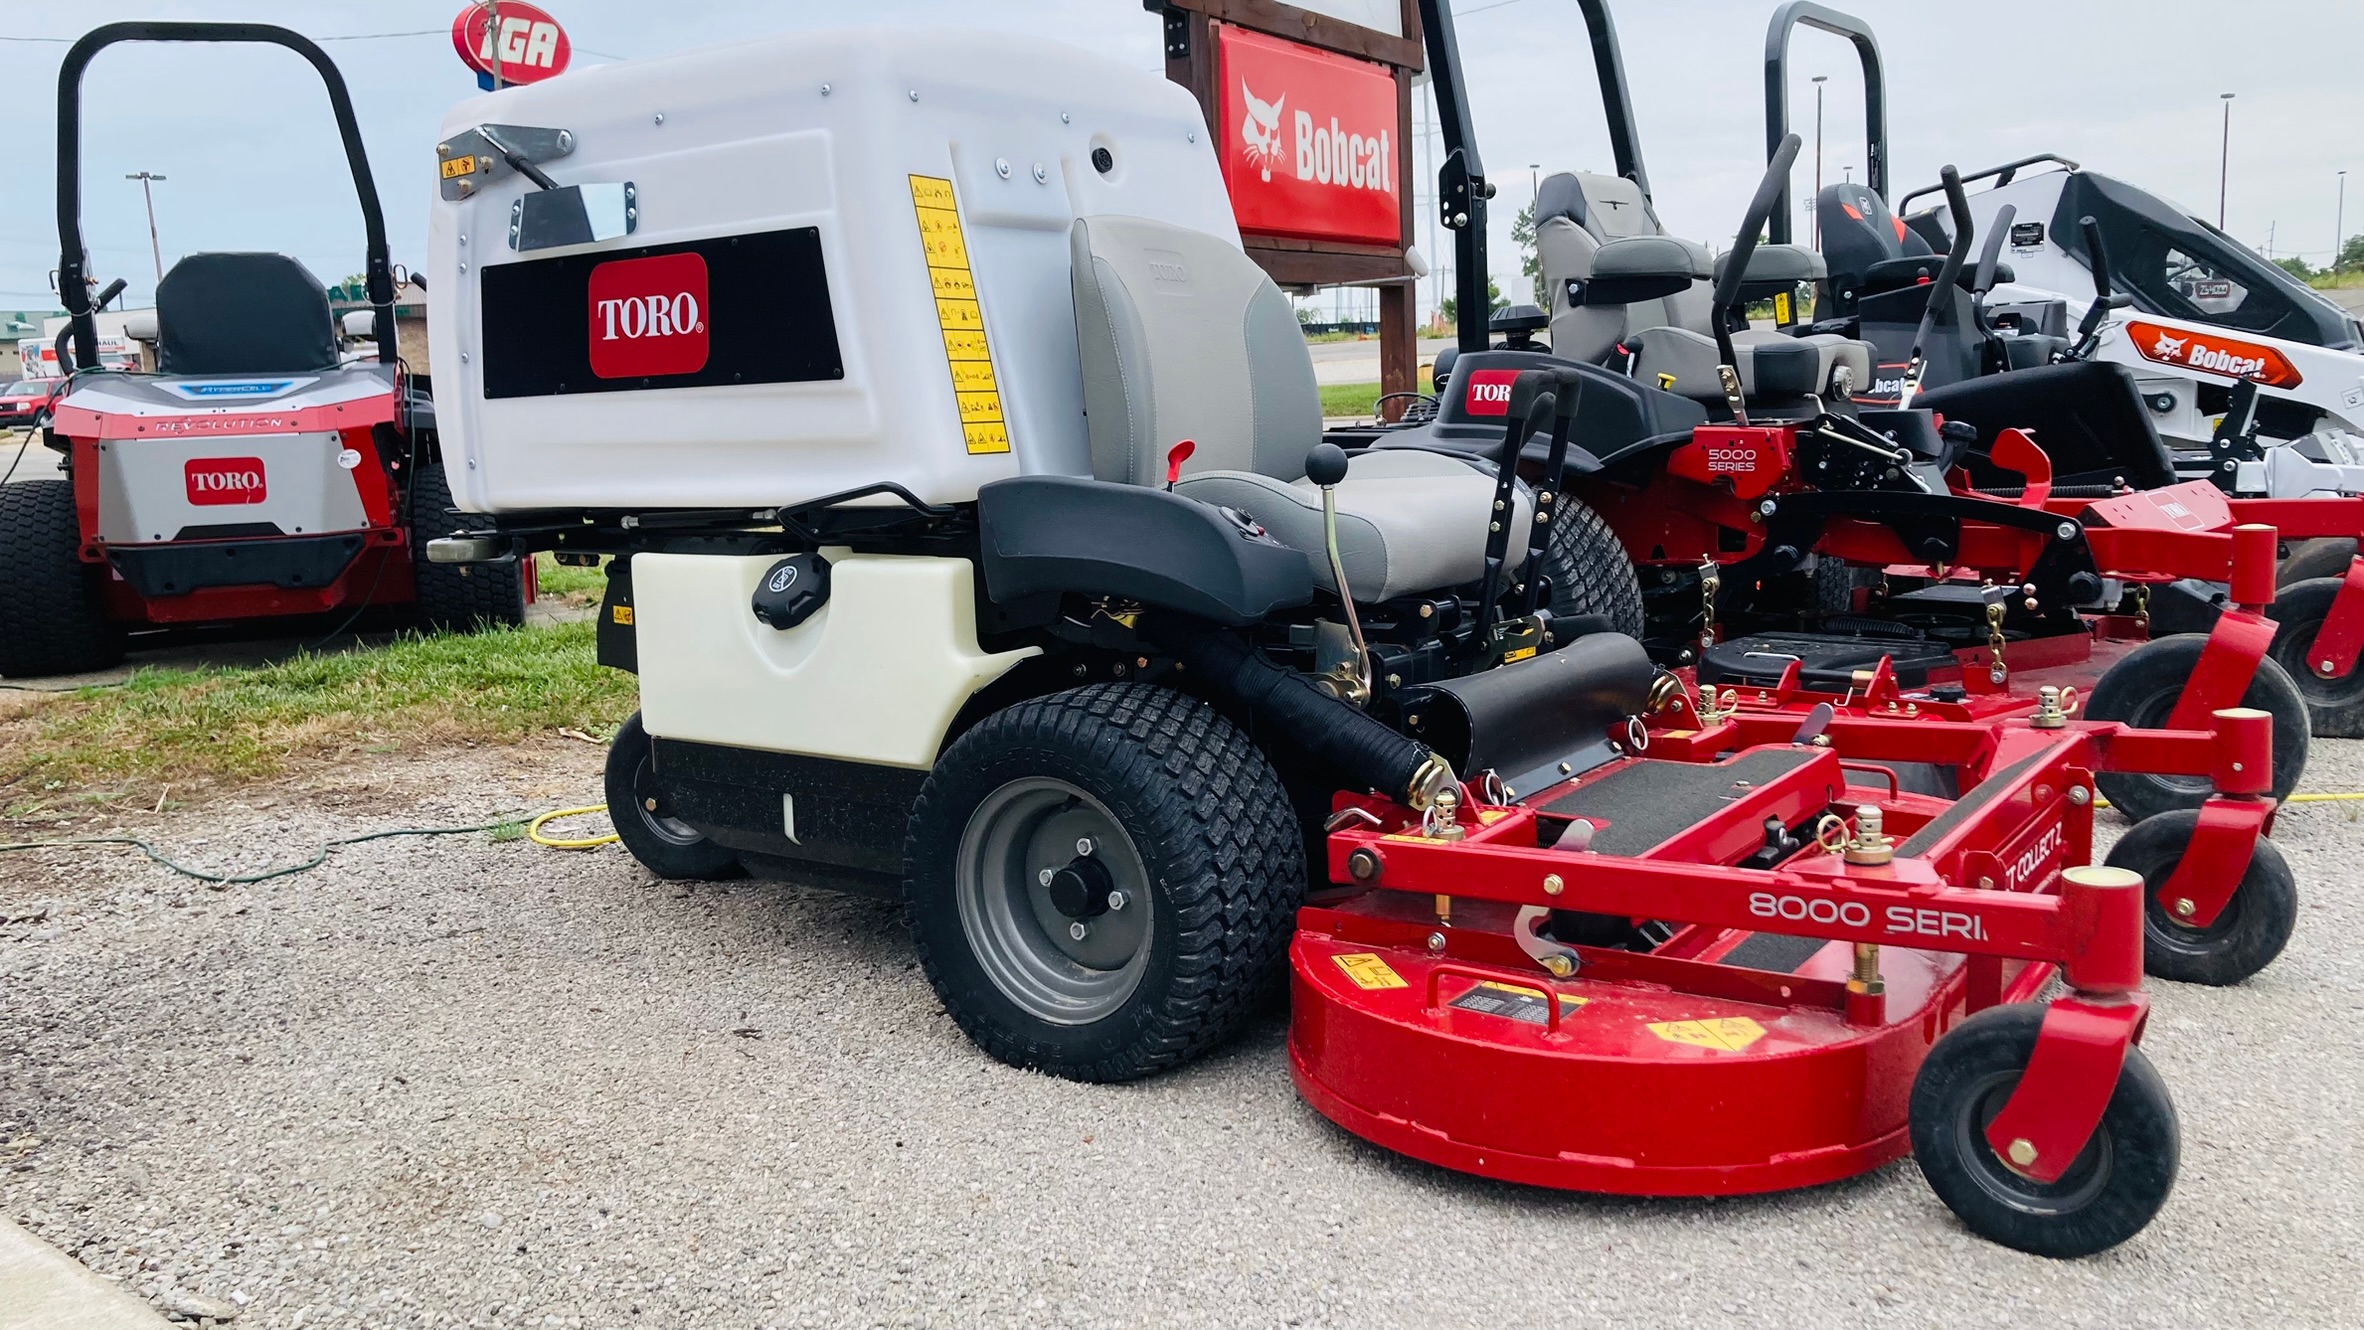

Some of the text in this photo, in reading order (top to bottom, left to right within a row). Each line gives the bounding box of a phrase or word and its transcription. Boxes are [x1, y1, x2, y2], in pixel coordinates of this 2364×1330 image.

[480, 15, 559, 68] IGA
[1295, 109, 1390, 193] Bobcat
[597, 291, 698, 341] TORO
[2188, 344, 2266, 378] Bobcat
[1472, 384, 1512, 402] TOR
[1875, 378, 1905, 393] bcat
[155, 416, 282, 435] REVOLUTION
[1708, 461, 1755, 472] SERIES
[1709, 449, 1757, 460] 5000
[192, 471, 259, 491] TORO
[2017, 828, 2056, 882] COLLECT
[1749, 892, 1989, 942] 8000 SERI
